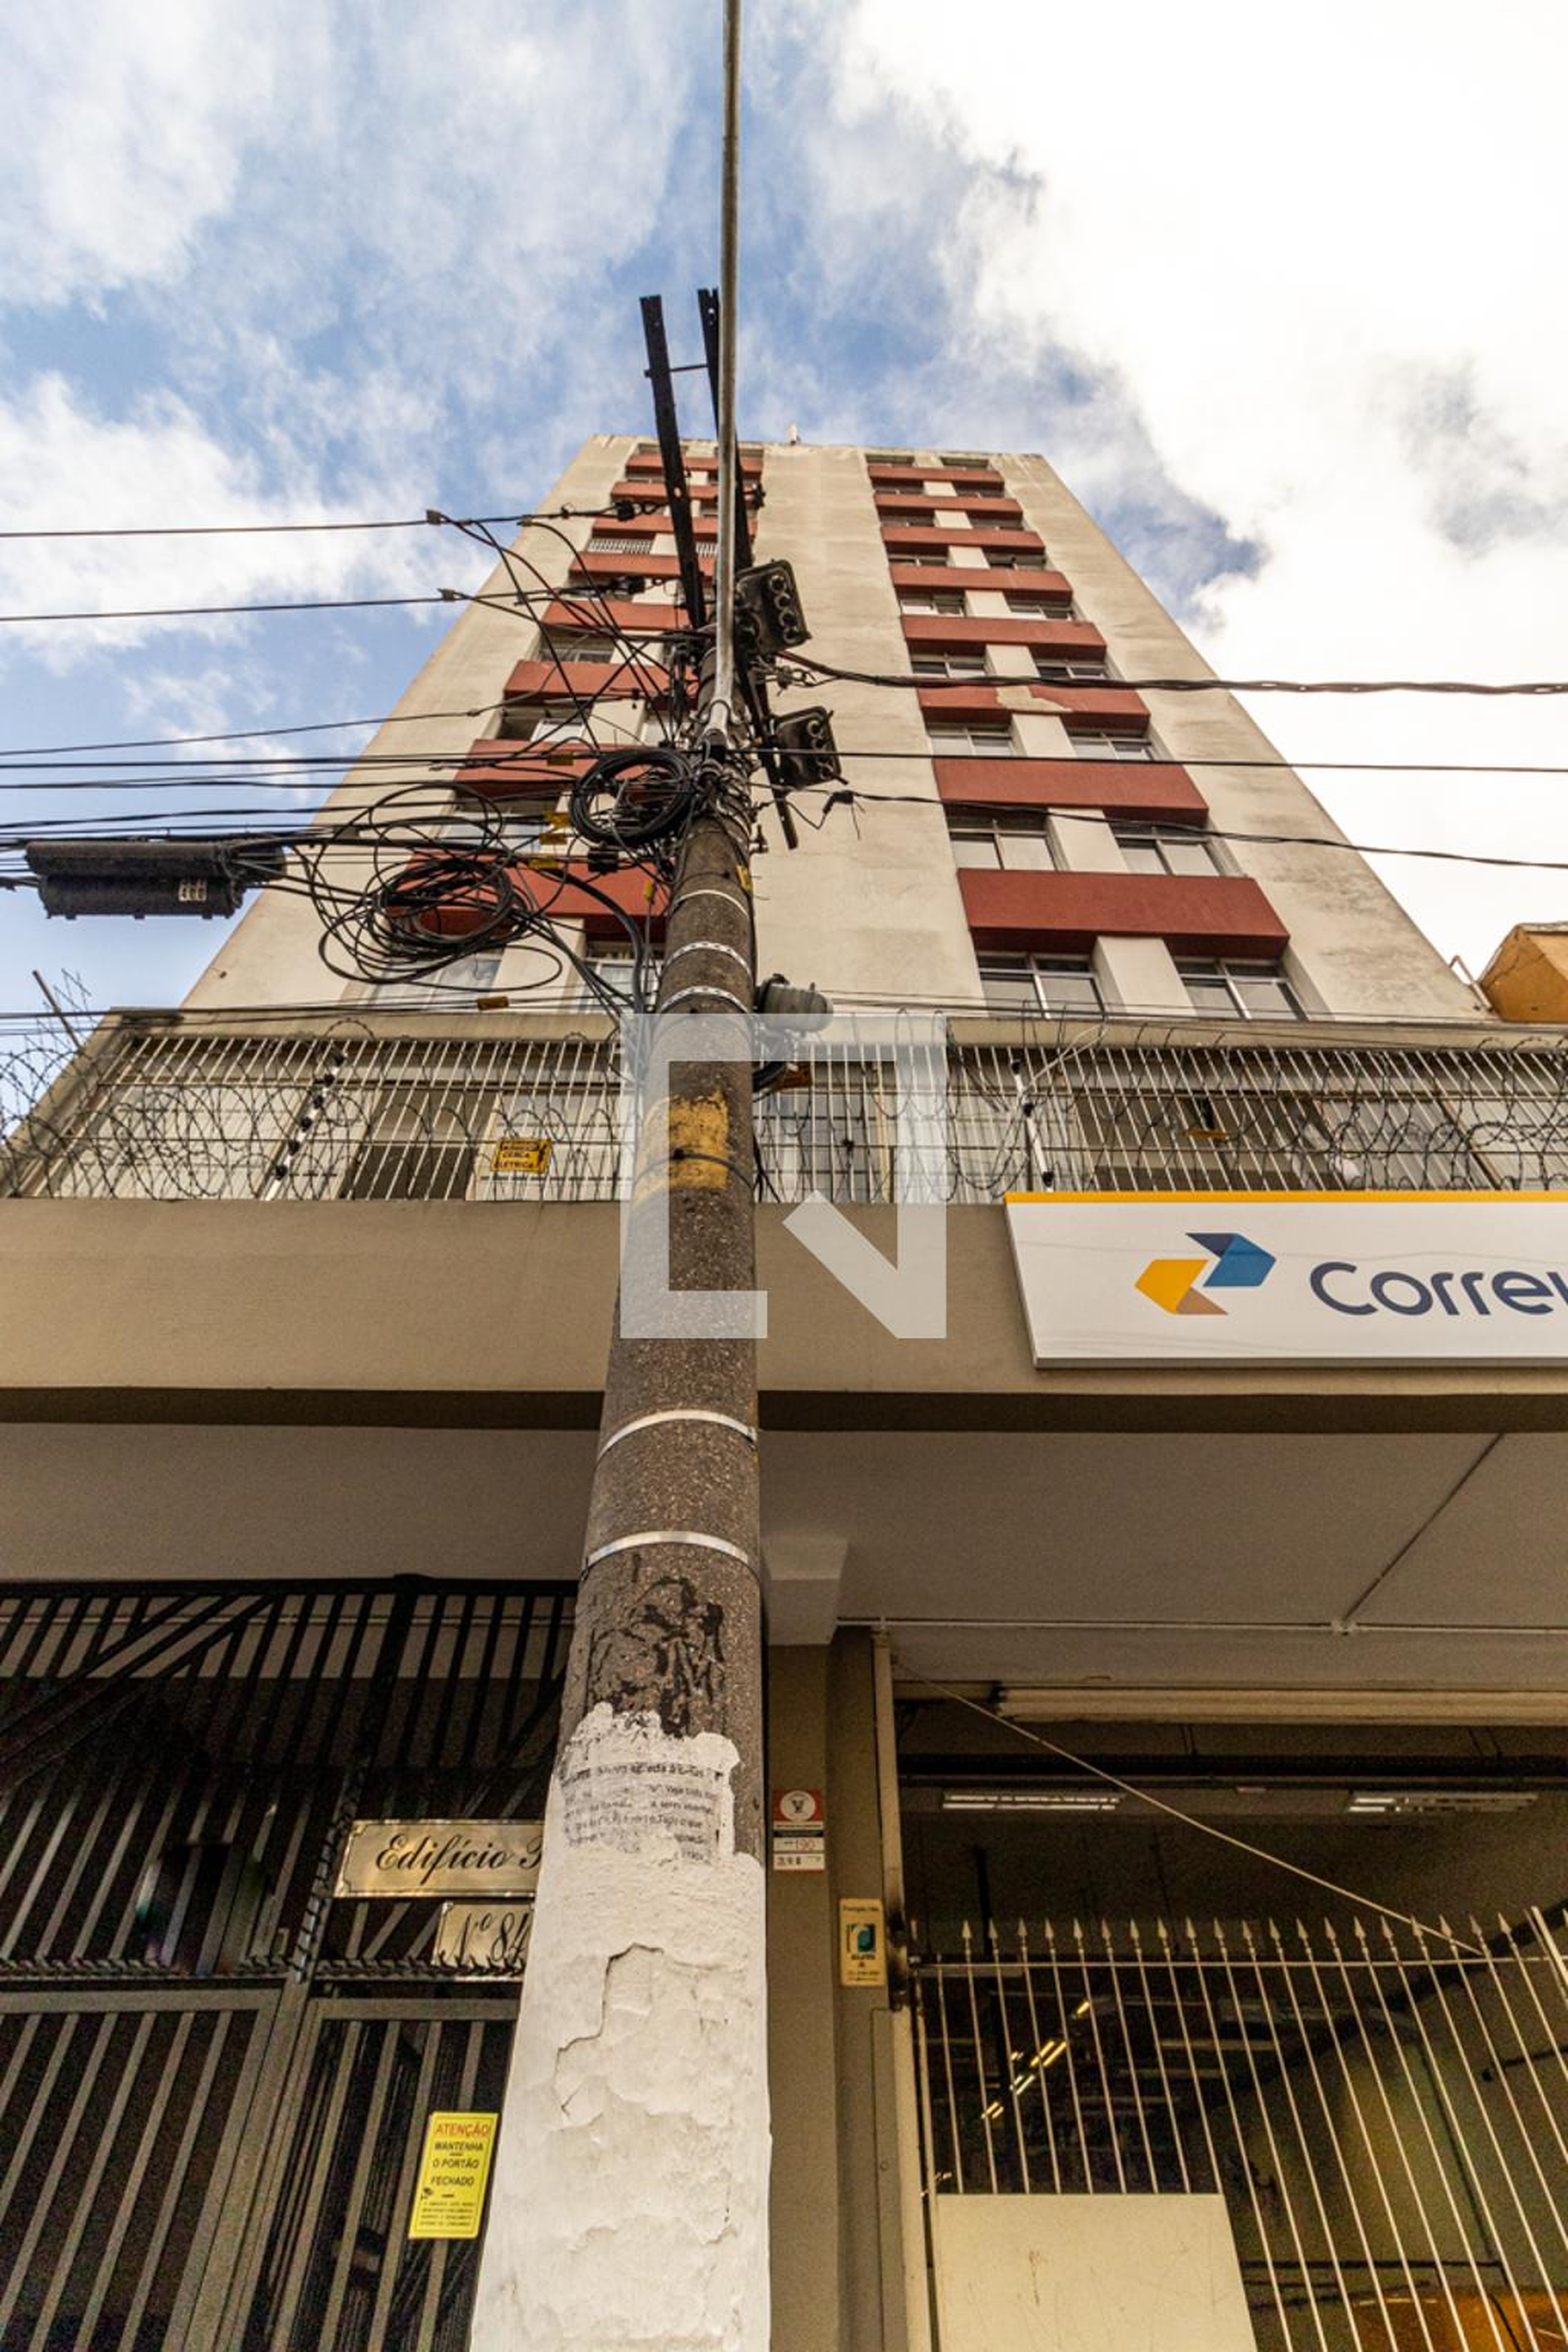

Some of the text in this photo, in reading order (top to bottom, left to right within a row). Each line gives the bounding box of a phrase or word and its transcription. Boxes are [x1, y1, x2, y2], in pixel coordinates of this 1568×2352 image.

[376, 1833, 514, 1886] Edifício
[436, 2122, 491, 2138] ATENÇÃO
[434, 2141, 483, 2152] MANTENHA
[433, 2157, 480, 2169] O PORTÃO
[430, 2176, 474, 2187] FECHADO
